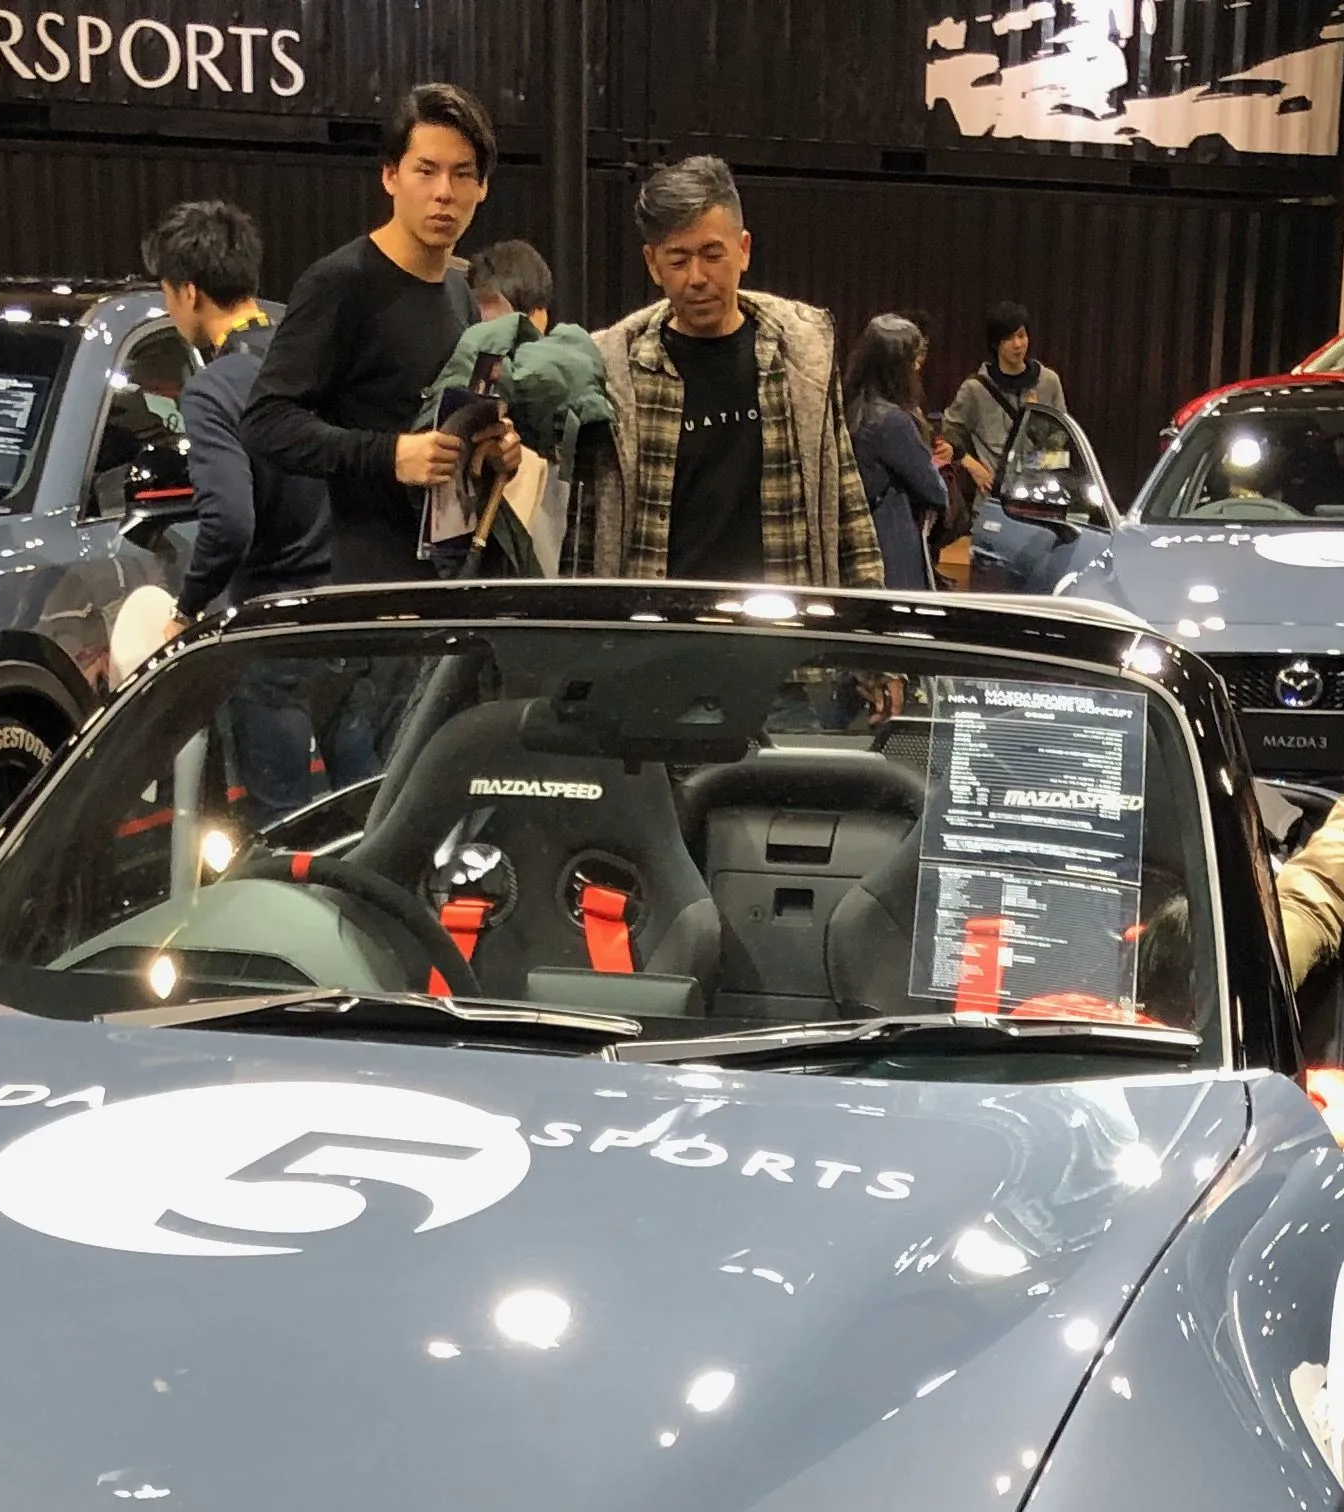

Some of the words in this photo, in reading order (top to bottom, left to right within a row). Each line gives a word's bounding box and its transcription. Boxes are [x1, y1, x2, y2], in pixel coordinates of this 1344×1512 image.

[469, 779, 603, 800] MAZDASPEED
[1003, 789, 1145, 811] MAZDASPEED
[529, 1121, 915, 1200] SPORTS
